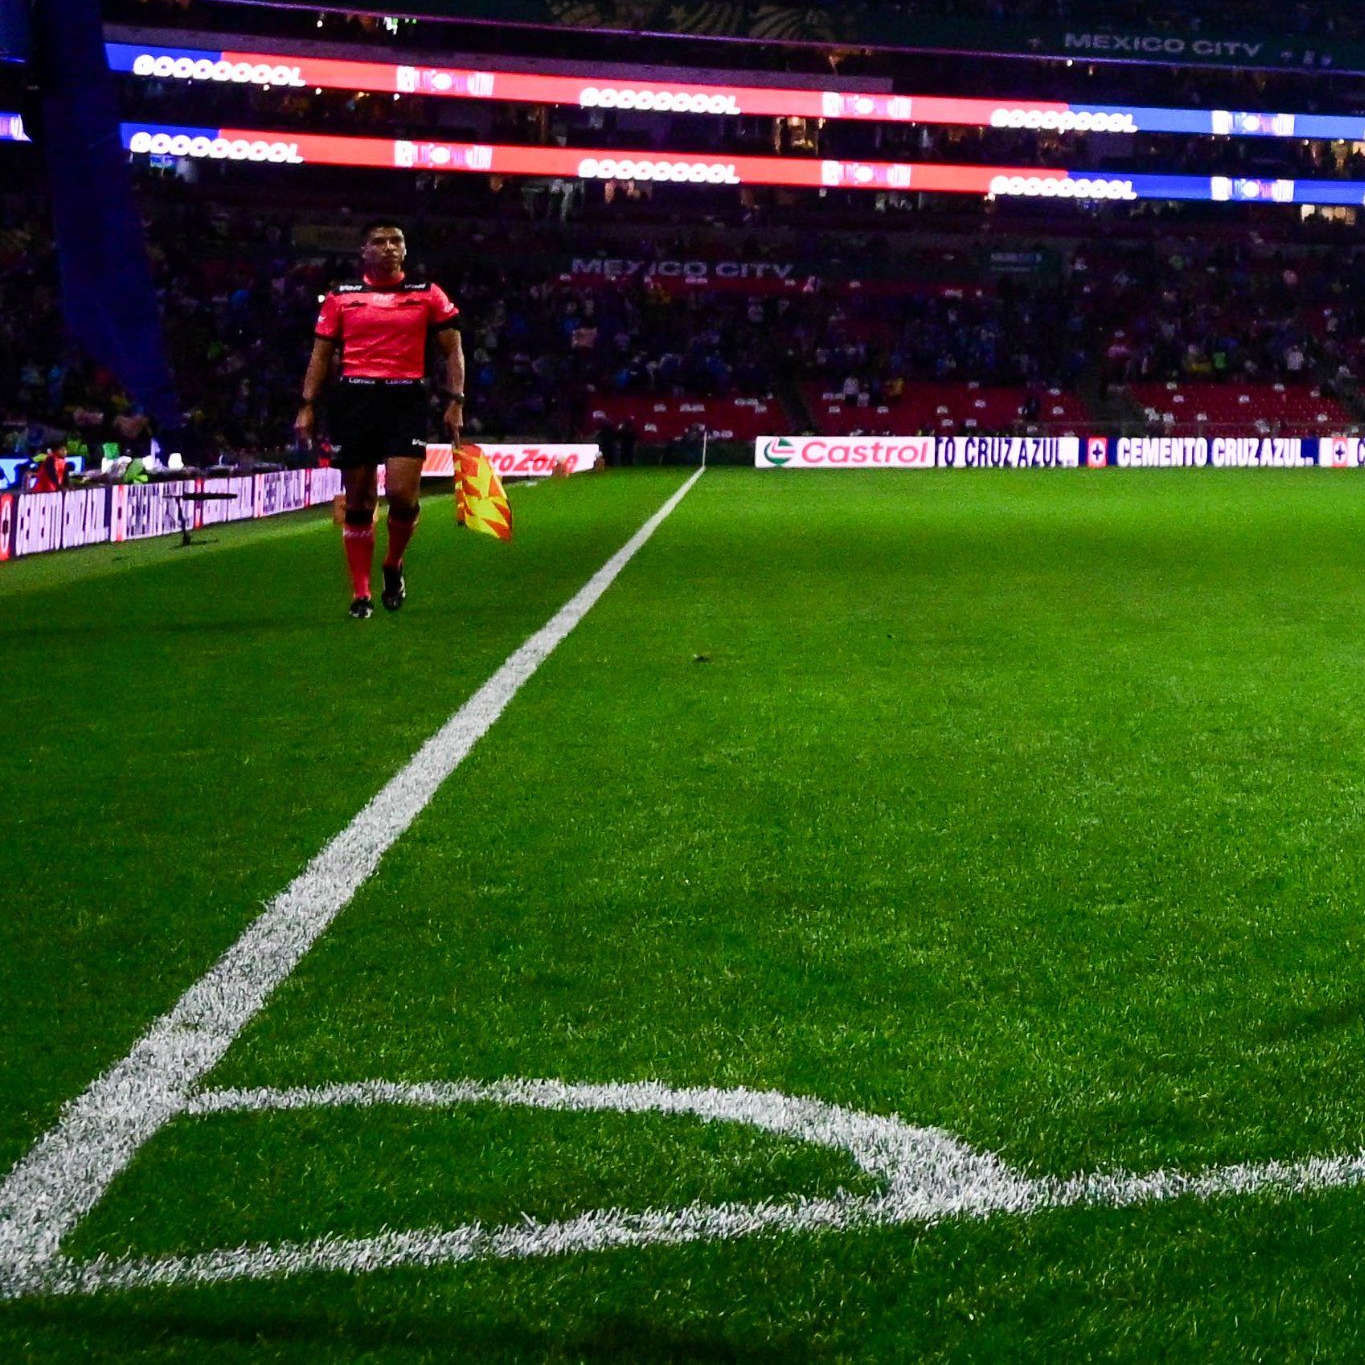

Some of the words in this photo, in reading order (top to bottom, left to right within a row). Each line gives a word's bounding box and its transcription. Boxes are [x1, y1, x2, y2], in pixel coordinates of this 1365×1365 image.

[1064, 32, 1185, 53] MEXICO
[1192, 39, 1263, 58] CITY
[715, 261, 794, 280] CITY
[802, 439, 929, 464] Castrol
[965, 437, 1012, 467] CRUZ
[1017, 437, 1062, 467] AZUL
[1117, 436, 1208, 468] CEMENTO
[1212, 436, 1260, 468] CRUZ
[1260, 436, 1304, 468] AZUL
